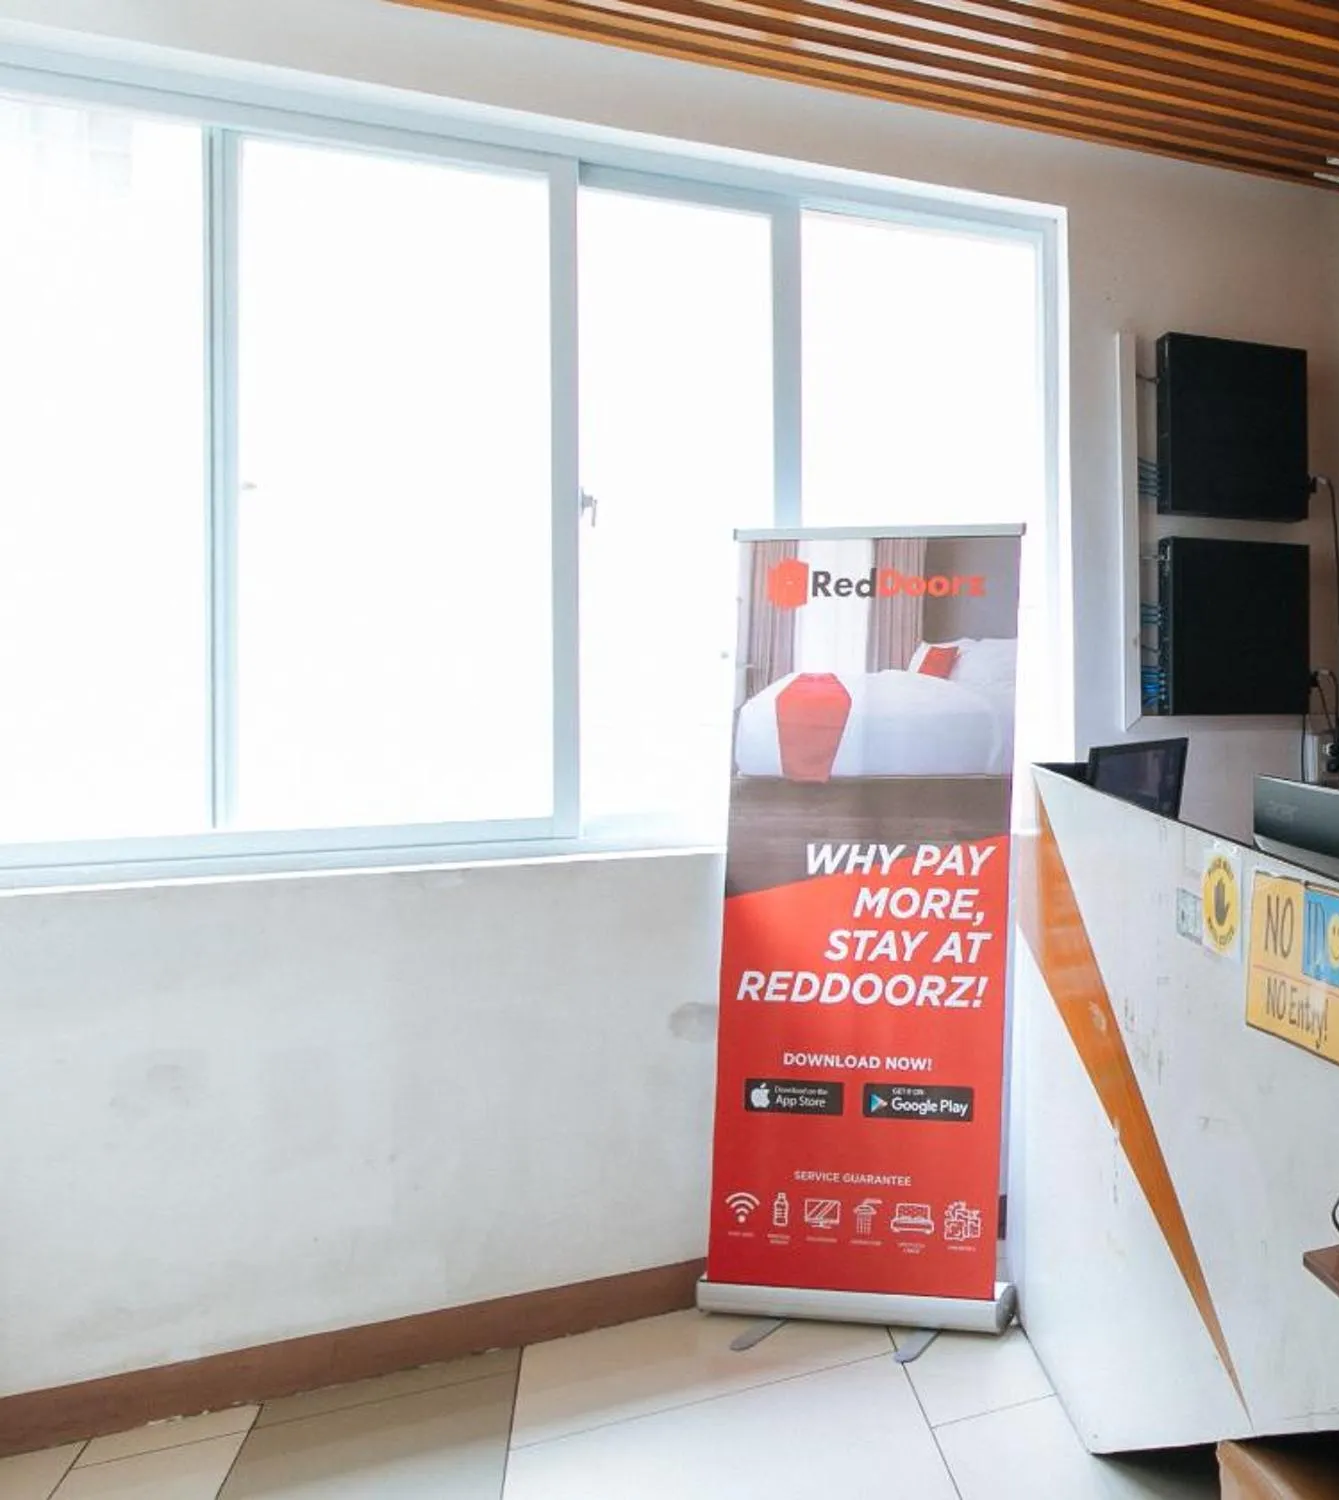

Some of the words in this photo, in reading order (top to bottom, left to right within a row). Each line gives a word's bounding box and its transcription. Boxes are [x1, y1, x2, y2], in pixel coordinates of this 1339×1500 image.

[811, 567, 987, 598] RedDoorz
[806, 844, 905, 876] WHY
[911, 845, 996, 877] PAY
[853, 887, 985, 926] MORE,
[1265, 894, 1295, 958] NO
[824, 930, 928, 962] STAY
[932, 932, 992, 963] AT
[736, 971, 988, 1008] REDDOORZ!
[1266, 976, 1287, 1021] NO
[1288, 986, 1329, 1050] Entry!
[783, 1053, 881, 1069] DOWNLOAD
[885, 1055, 933, 1072] NOW!
[775, 1095, 798, 1107] App
[799, 1096, 827, 1108] Store
[891, 1097, 938, 1115] Google
[940, 1099, 969, 1118] Play
[793, 1170, 840, 1184] SERVICE
[843, 1172, 912, 1187] GUARANTEE
